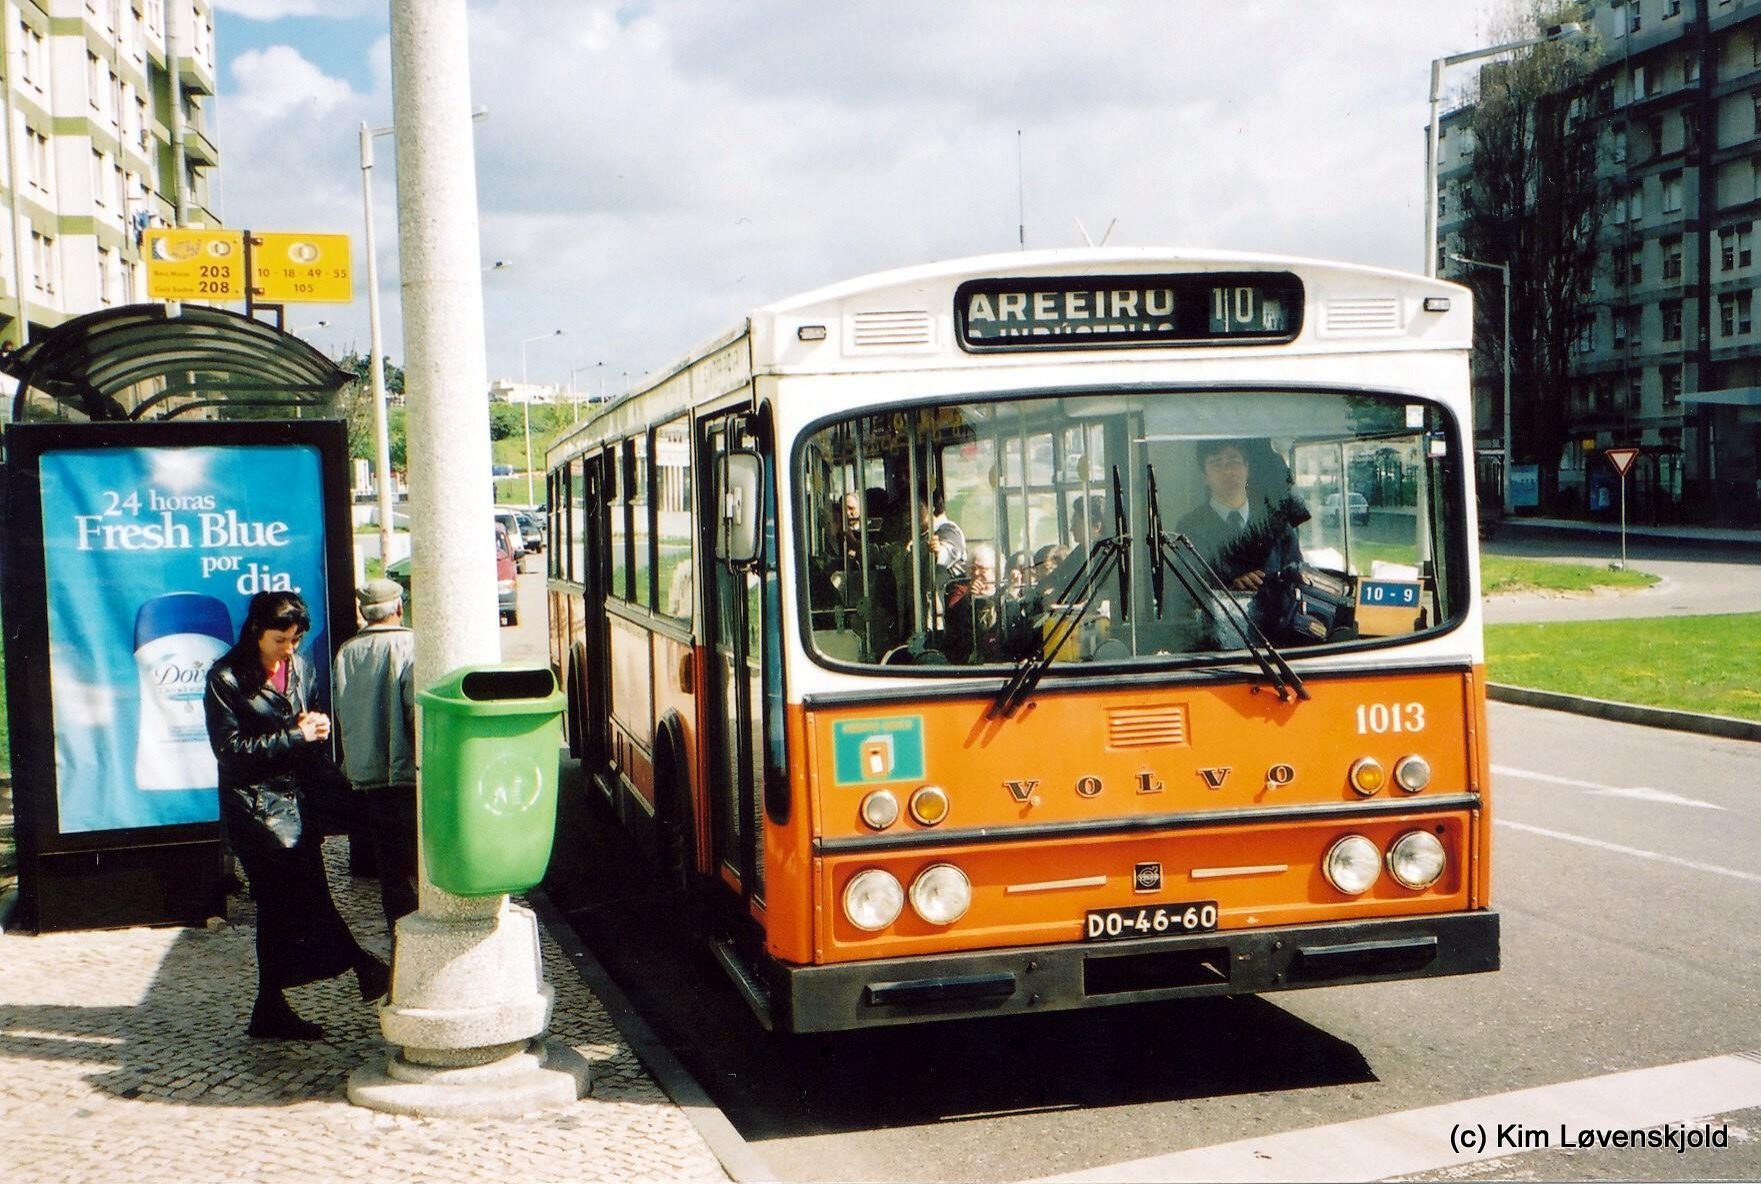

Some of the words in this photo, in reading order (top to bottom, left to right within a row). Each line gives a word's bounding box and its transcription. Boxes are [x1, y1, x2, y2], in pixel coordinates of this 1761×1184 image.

[200, 265, 230, 278] 203
[258, 268, 270, 278] 10
[283, 268, 295, 278] 18
[308, 268, 321, 278] 49
[333, 269, 347, 279] 55
[199, 281, 229, 293] 208
[294, 283, 313, 293] 105
[968, 287, 1175, 323] AREEIRO
[103, 491, 142, 516] 24
[149, 489, 216, 511] horas
[74, 511, 192, 551] Fresh
[198, 509, 289, 548] Blue
[201, 555, 242, 578] por
[236, 563, 302, 595] dia.
[1366, 586, 1383, 601] 10
[1403, 588, 1413, 602] 9
[154, 663, 206, 686] Dov
[1355, 702, 1426, 735] 1013
[1087, 905, 1217, 938] DO-46-60
